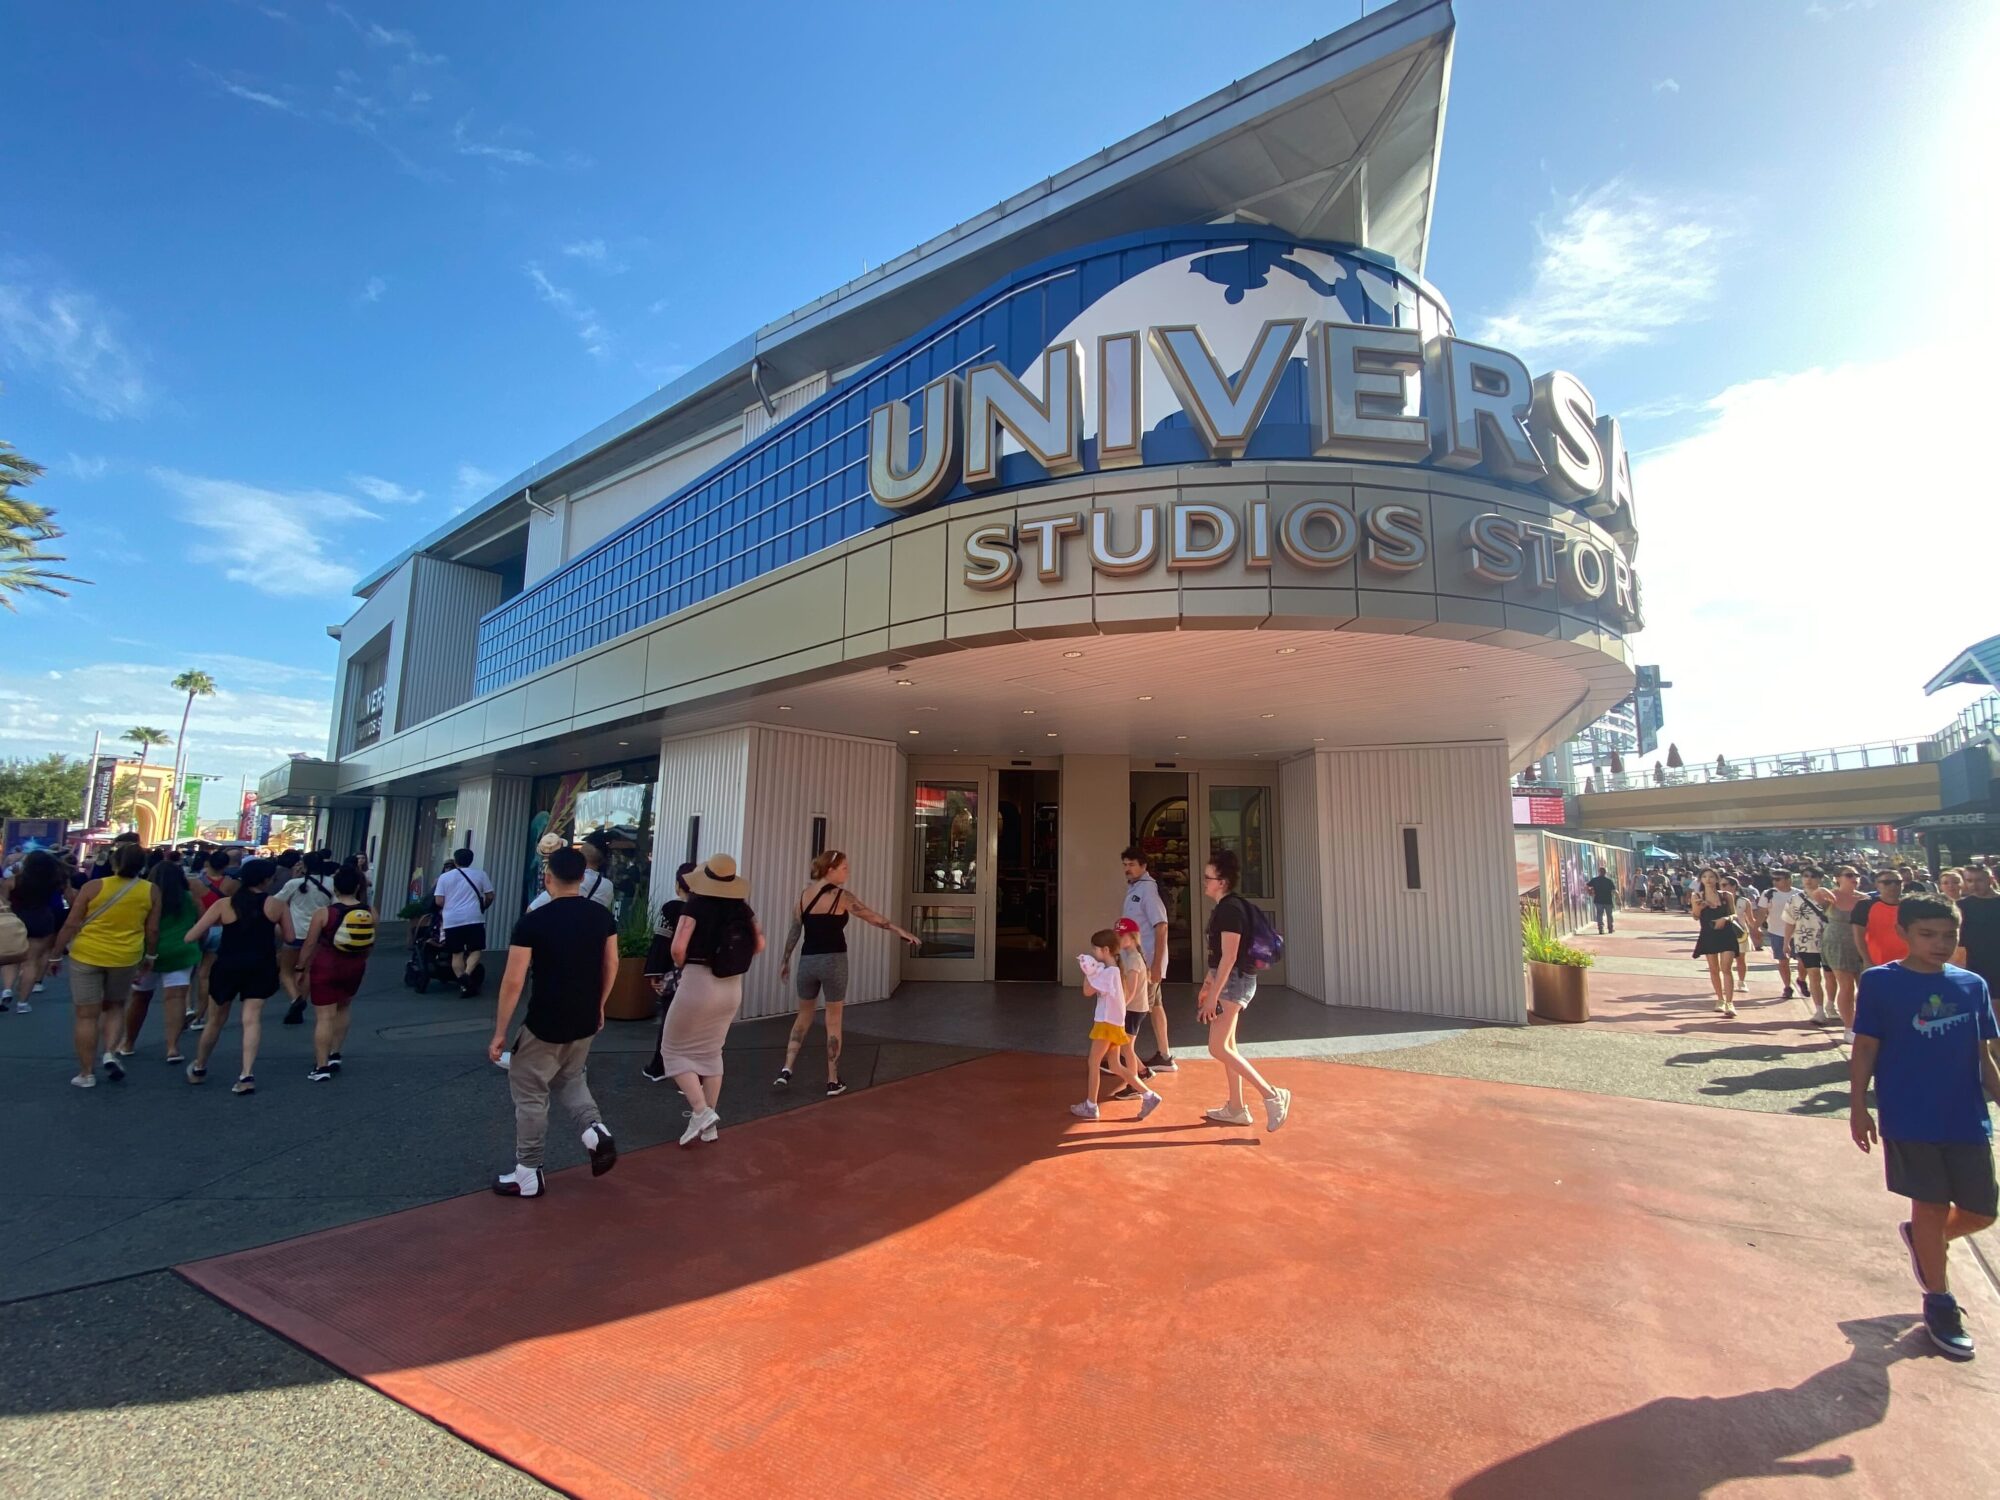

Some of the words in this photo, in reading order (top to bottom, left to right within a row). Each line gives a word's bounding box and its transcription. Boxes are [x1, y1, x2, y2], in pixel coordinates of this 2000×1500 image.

[868, 317, 1638, 566] UNIVERSA
[963, 498, 1426, 591] STUDIOS
[98, 771, 112, 821] RESTAURANT
[1919, 813, 1985, 826] CONCIERGE
